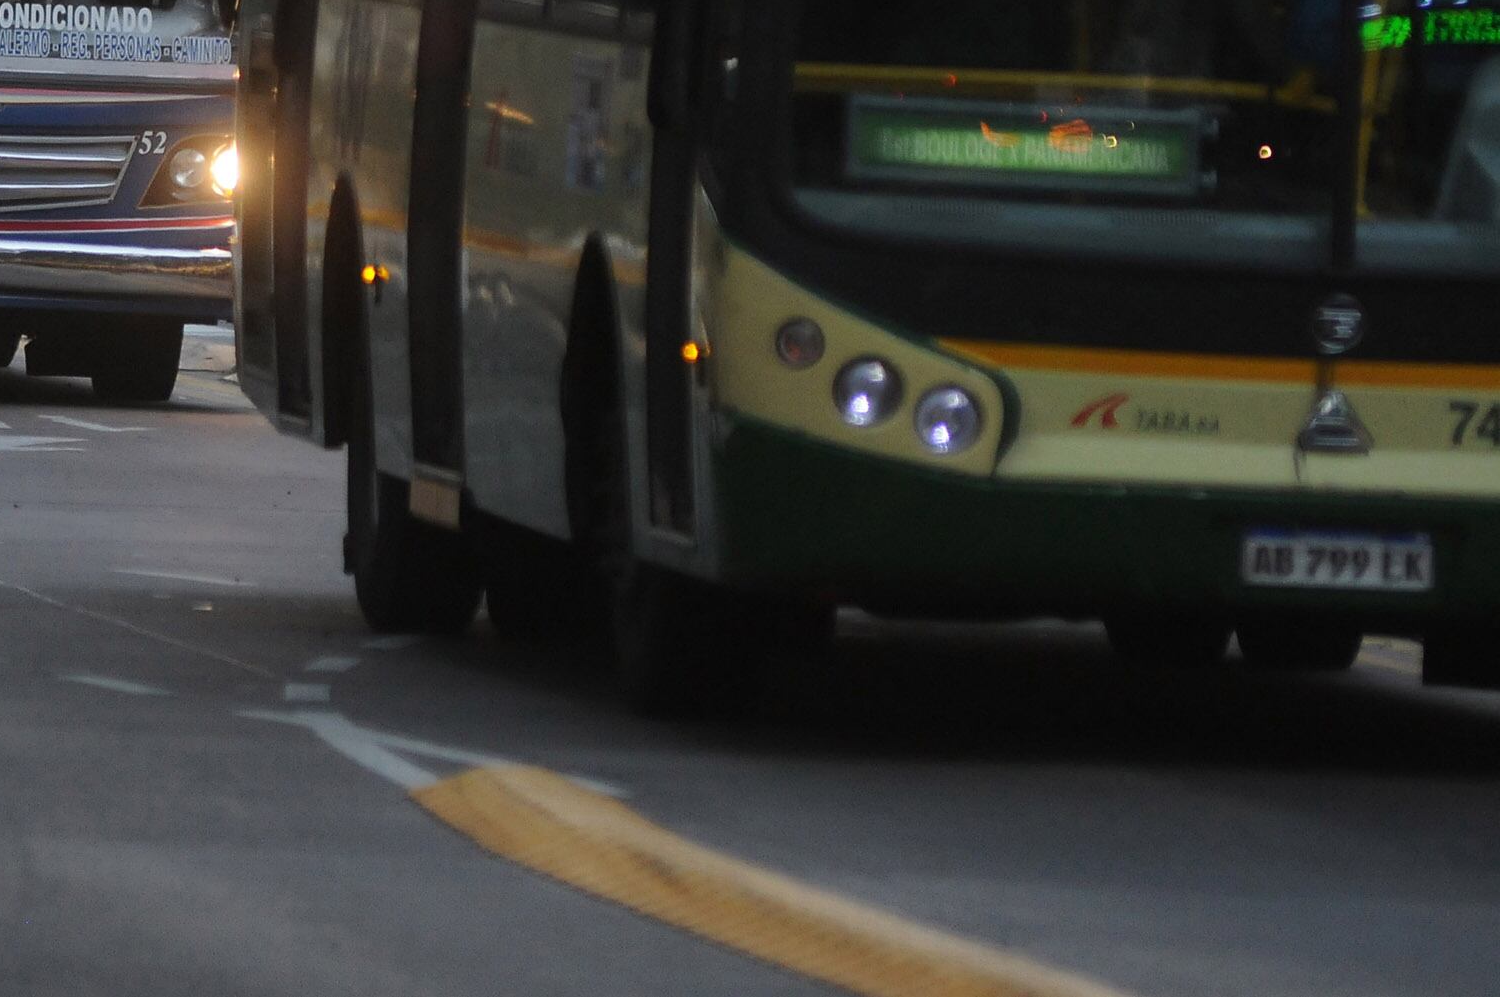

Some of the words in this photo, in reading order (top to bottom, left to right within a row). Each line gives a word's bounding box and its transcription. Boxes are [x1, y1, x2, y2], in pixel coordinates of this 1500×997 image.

[93, 32, 162, 62] PERSONAS
[171, 36, 232, 65] CAMINITO
[138, 130, 167, 154] 52
[1253, 545, 1295, 576] AB
[1306, 546, 1371, 578] 799
